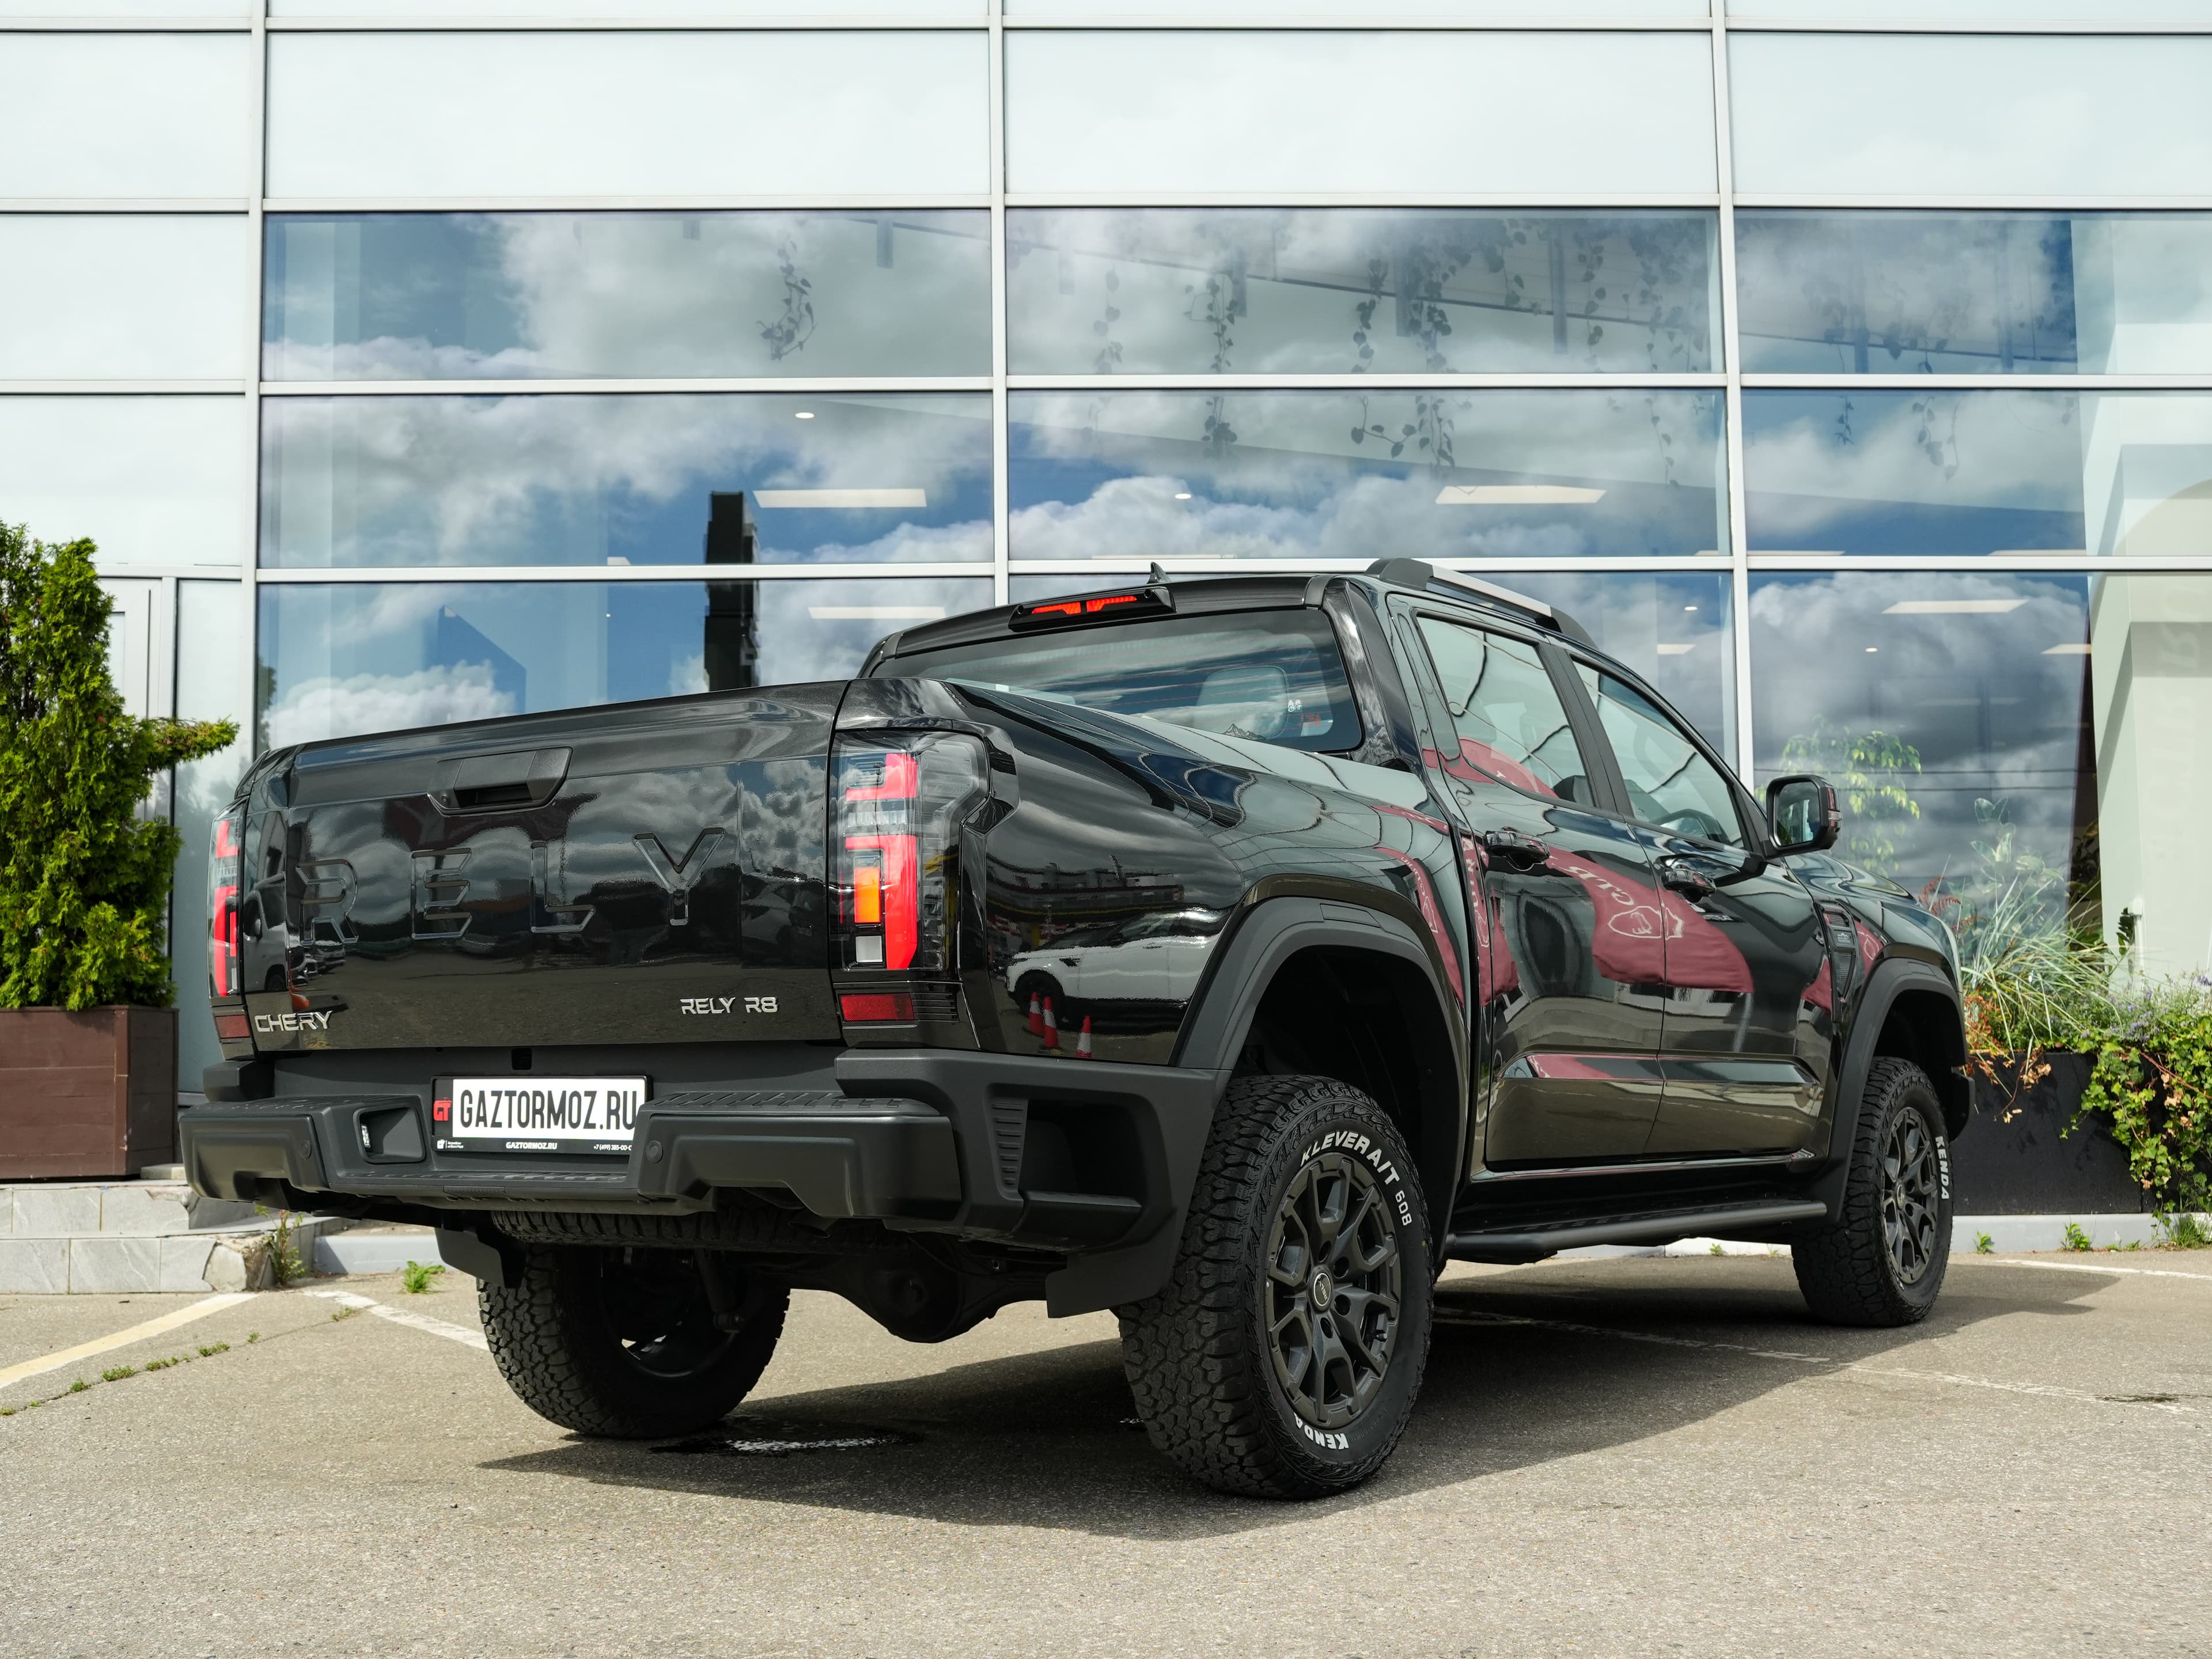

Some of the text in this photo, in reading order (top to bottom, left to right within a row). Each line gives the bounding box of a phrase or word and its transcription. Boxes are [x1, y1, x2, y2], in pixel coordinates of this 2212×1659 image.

[296, 828, 725, 946] RELY
[255, 1010, 332, 1032] CHERY
[680, 997, 779, 1014] RELY R8
[461, 1089, 637, 1130] GAZTORMOZ.RU
[506, 1142, 558, 1150] GAZTORMOZ.RU
[1301, 1131, 1370, 1166] KLEVER
[1396, 1190, 1412, 1226] 608
[1936, 1136, 1949, 1199] KENDA
[1294, 1412, 1349, 1450] KENDA
